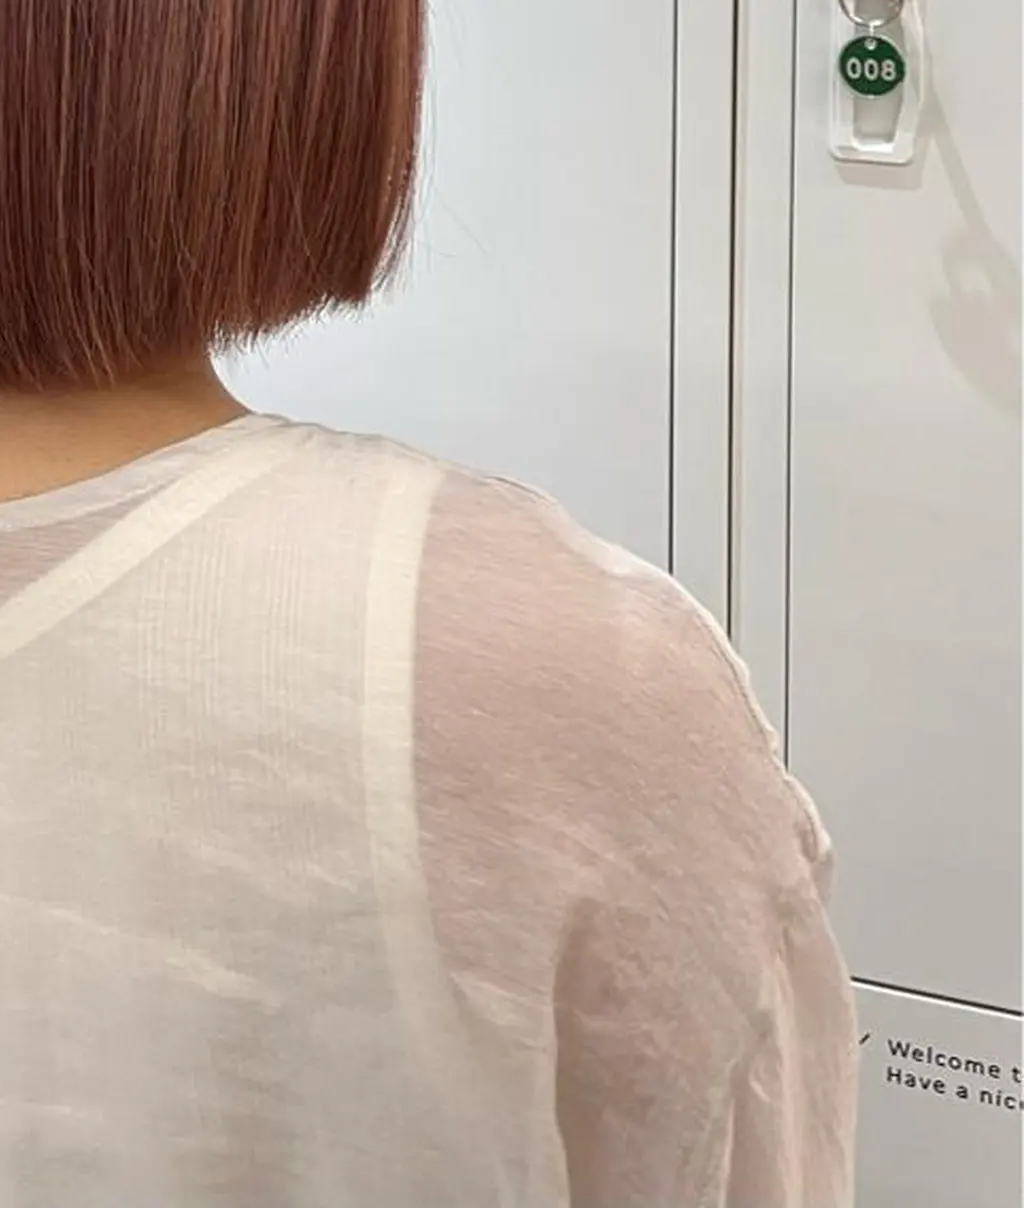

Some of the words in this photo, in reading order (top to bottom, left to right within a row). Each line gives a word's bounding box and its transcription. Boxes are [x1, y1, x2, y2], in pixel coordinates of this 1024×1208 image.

[846, 57, 897, 82] 008
[887, 1038, 1002, 1080] Welcome
[887, 1066, 947, 1095] Have
[956, 1085, 969, 1100] a
